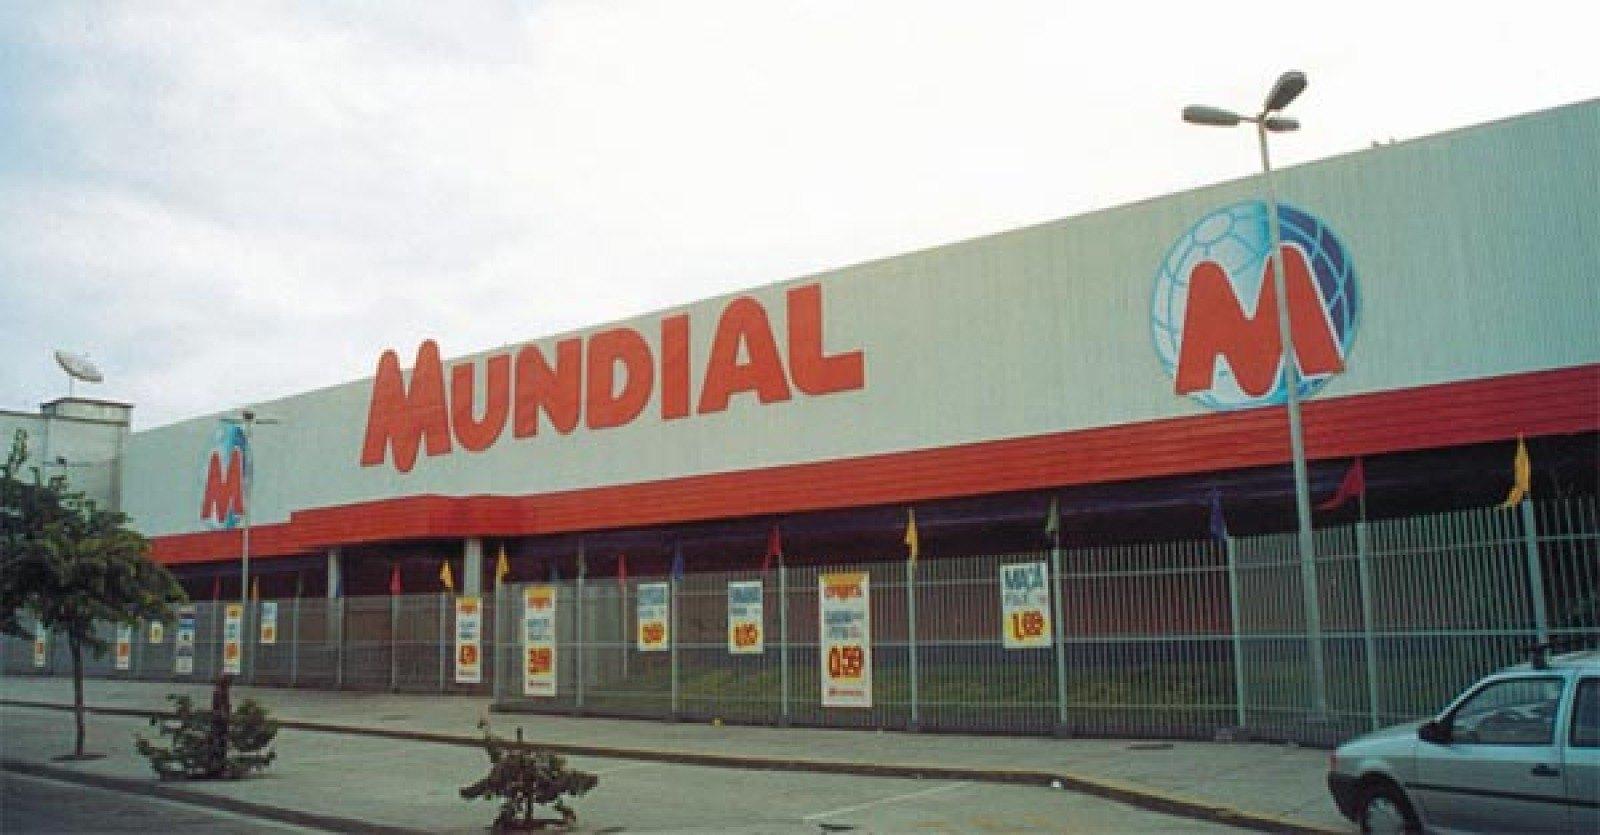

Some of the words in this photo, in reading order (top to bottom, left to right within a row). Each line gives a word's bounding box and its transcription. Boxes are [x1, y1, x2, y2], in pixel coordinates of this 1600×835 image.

[360, 283, 864, 472] MUNDIAL
[1176, 244, 1345, 398] M
[202, 449, 244, 522] M
